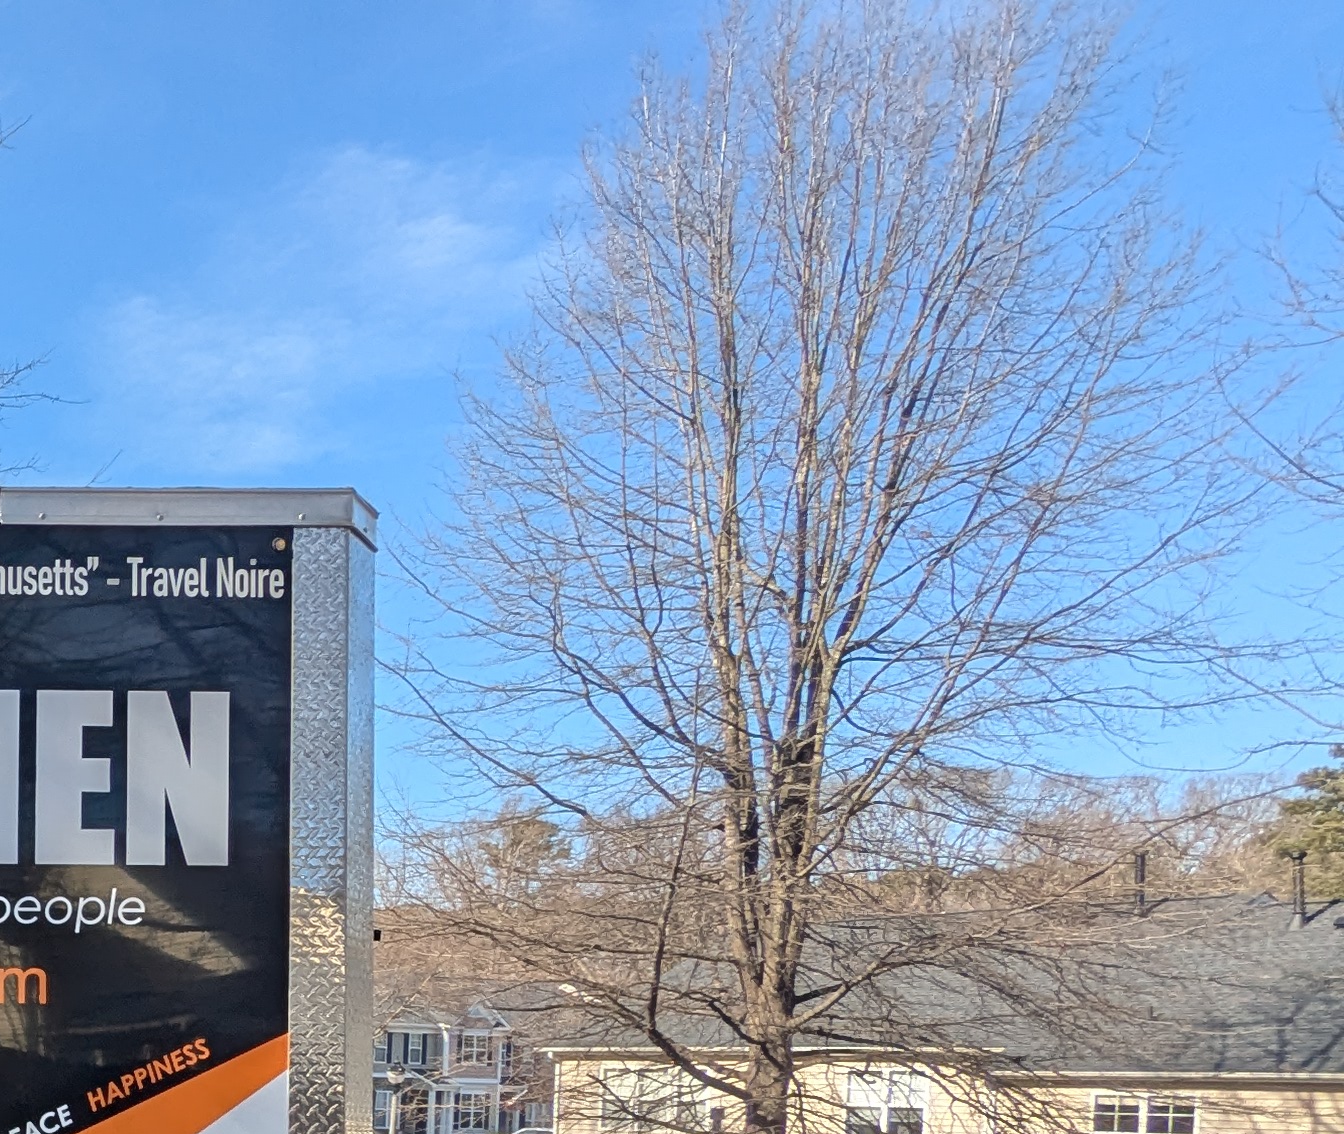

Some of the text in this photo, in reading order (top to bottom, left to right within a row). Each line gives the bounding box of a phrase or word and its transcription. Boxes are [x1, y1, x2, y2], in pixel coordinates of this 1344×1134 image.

[126, 556, 210, 598] Travel
[216, 557, 285, 598] Noire
[86, 1038, 212, 1113] HAPPINESS
